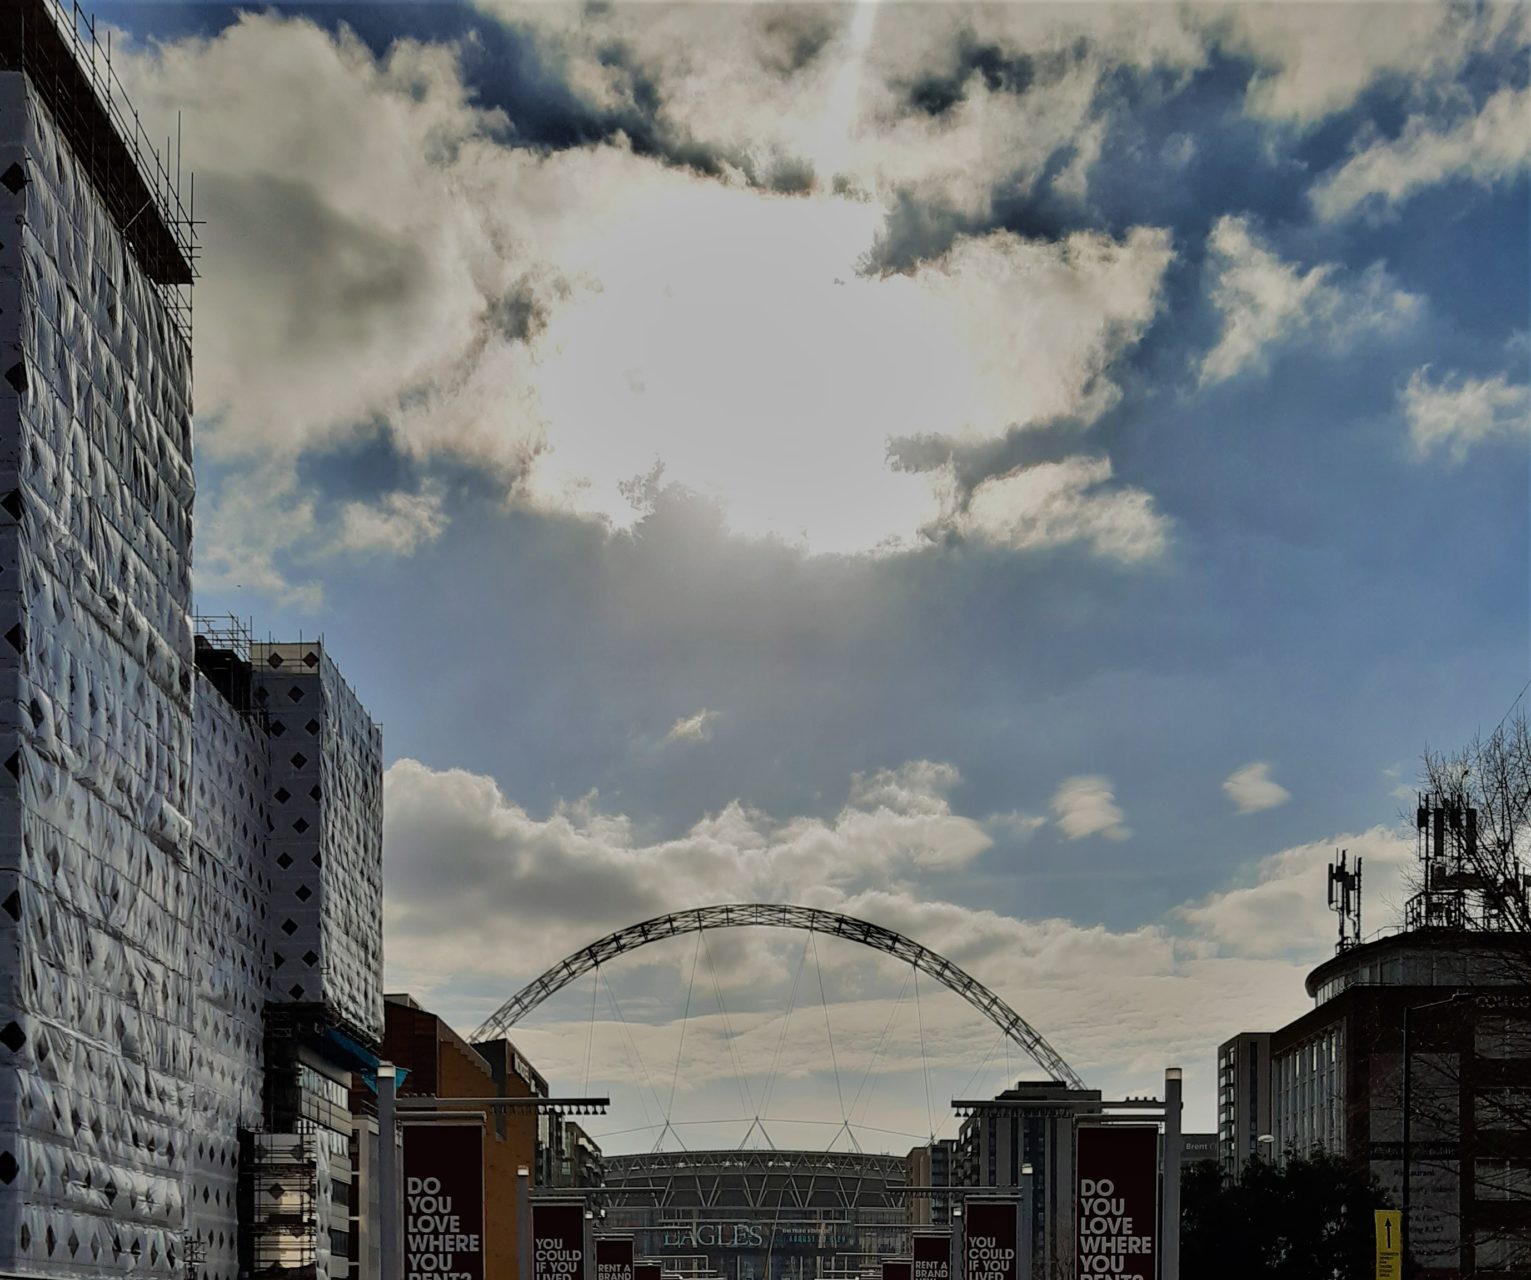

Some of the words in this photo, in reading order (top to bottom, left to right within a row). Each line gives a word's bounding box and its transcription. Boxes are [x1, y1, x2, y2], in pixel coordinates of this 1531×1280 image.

[1186, 1142, 1208, 1150] Brent
[408, 1177, 441, 1195] DO
[1081, 1179, 1114, 1197] DO
[408, 1196, 452, 1214] YOU
[1081, 1198, 1125, 1215] YOU
[408, 1215, 460, 1233] LOVE
[1081, 1217, 1133, 1234] LOVE
[408, 1234, 480, 1252] WHERE
[536, 1239, 563, 1250] YOU
[968, 1237, 996, 1248] YOU
[1080, 1236, 1152, 1254] WHERE
[536, 1250, 582, 1262] COULD
[968, 1248, 1015, 1260] COULD
[408, 1253, 452, 1272] YOU
[536, 1262, 547, 1273] IF
[550, 1262, 577, 1273] YOU
[598, 1264, 622, 1273] RENT
[623, 1264, 631, 1273] A
[915, 1261, 938, 1270] RENT
[940, 1261, 948, 1270] A
[969, 1260, 979, 1271] IF
[982, 1260, 1010, 1271] YOU
[1080, 1255, 1125, 1273] YOU
[598, 1272, 632, 1280] BRAND
[915, 1269, 949, 1278] BRAND
